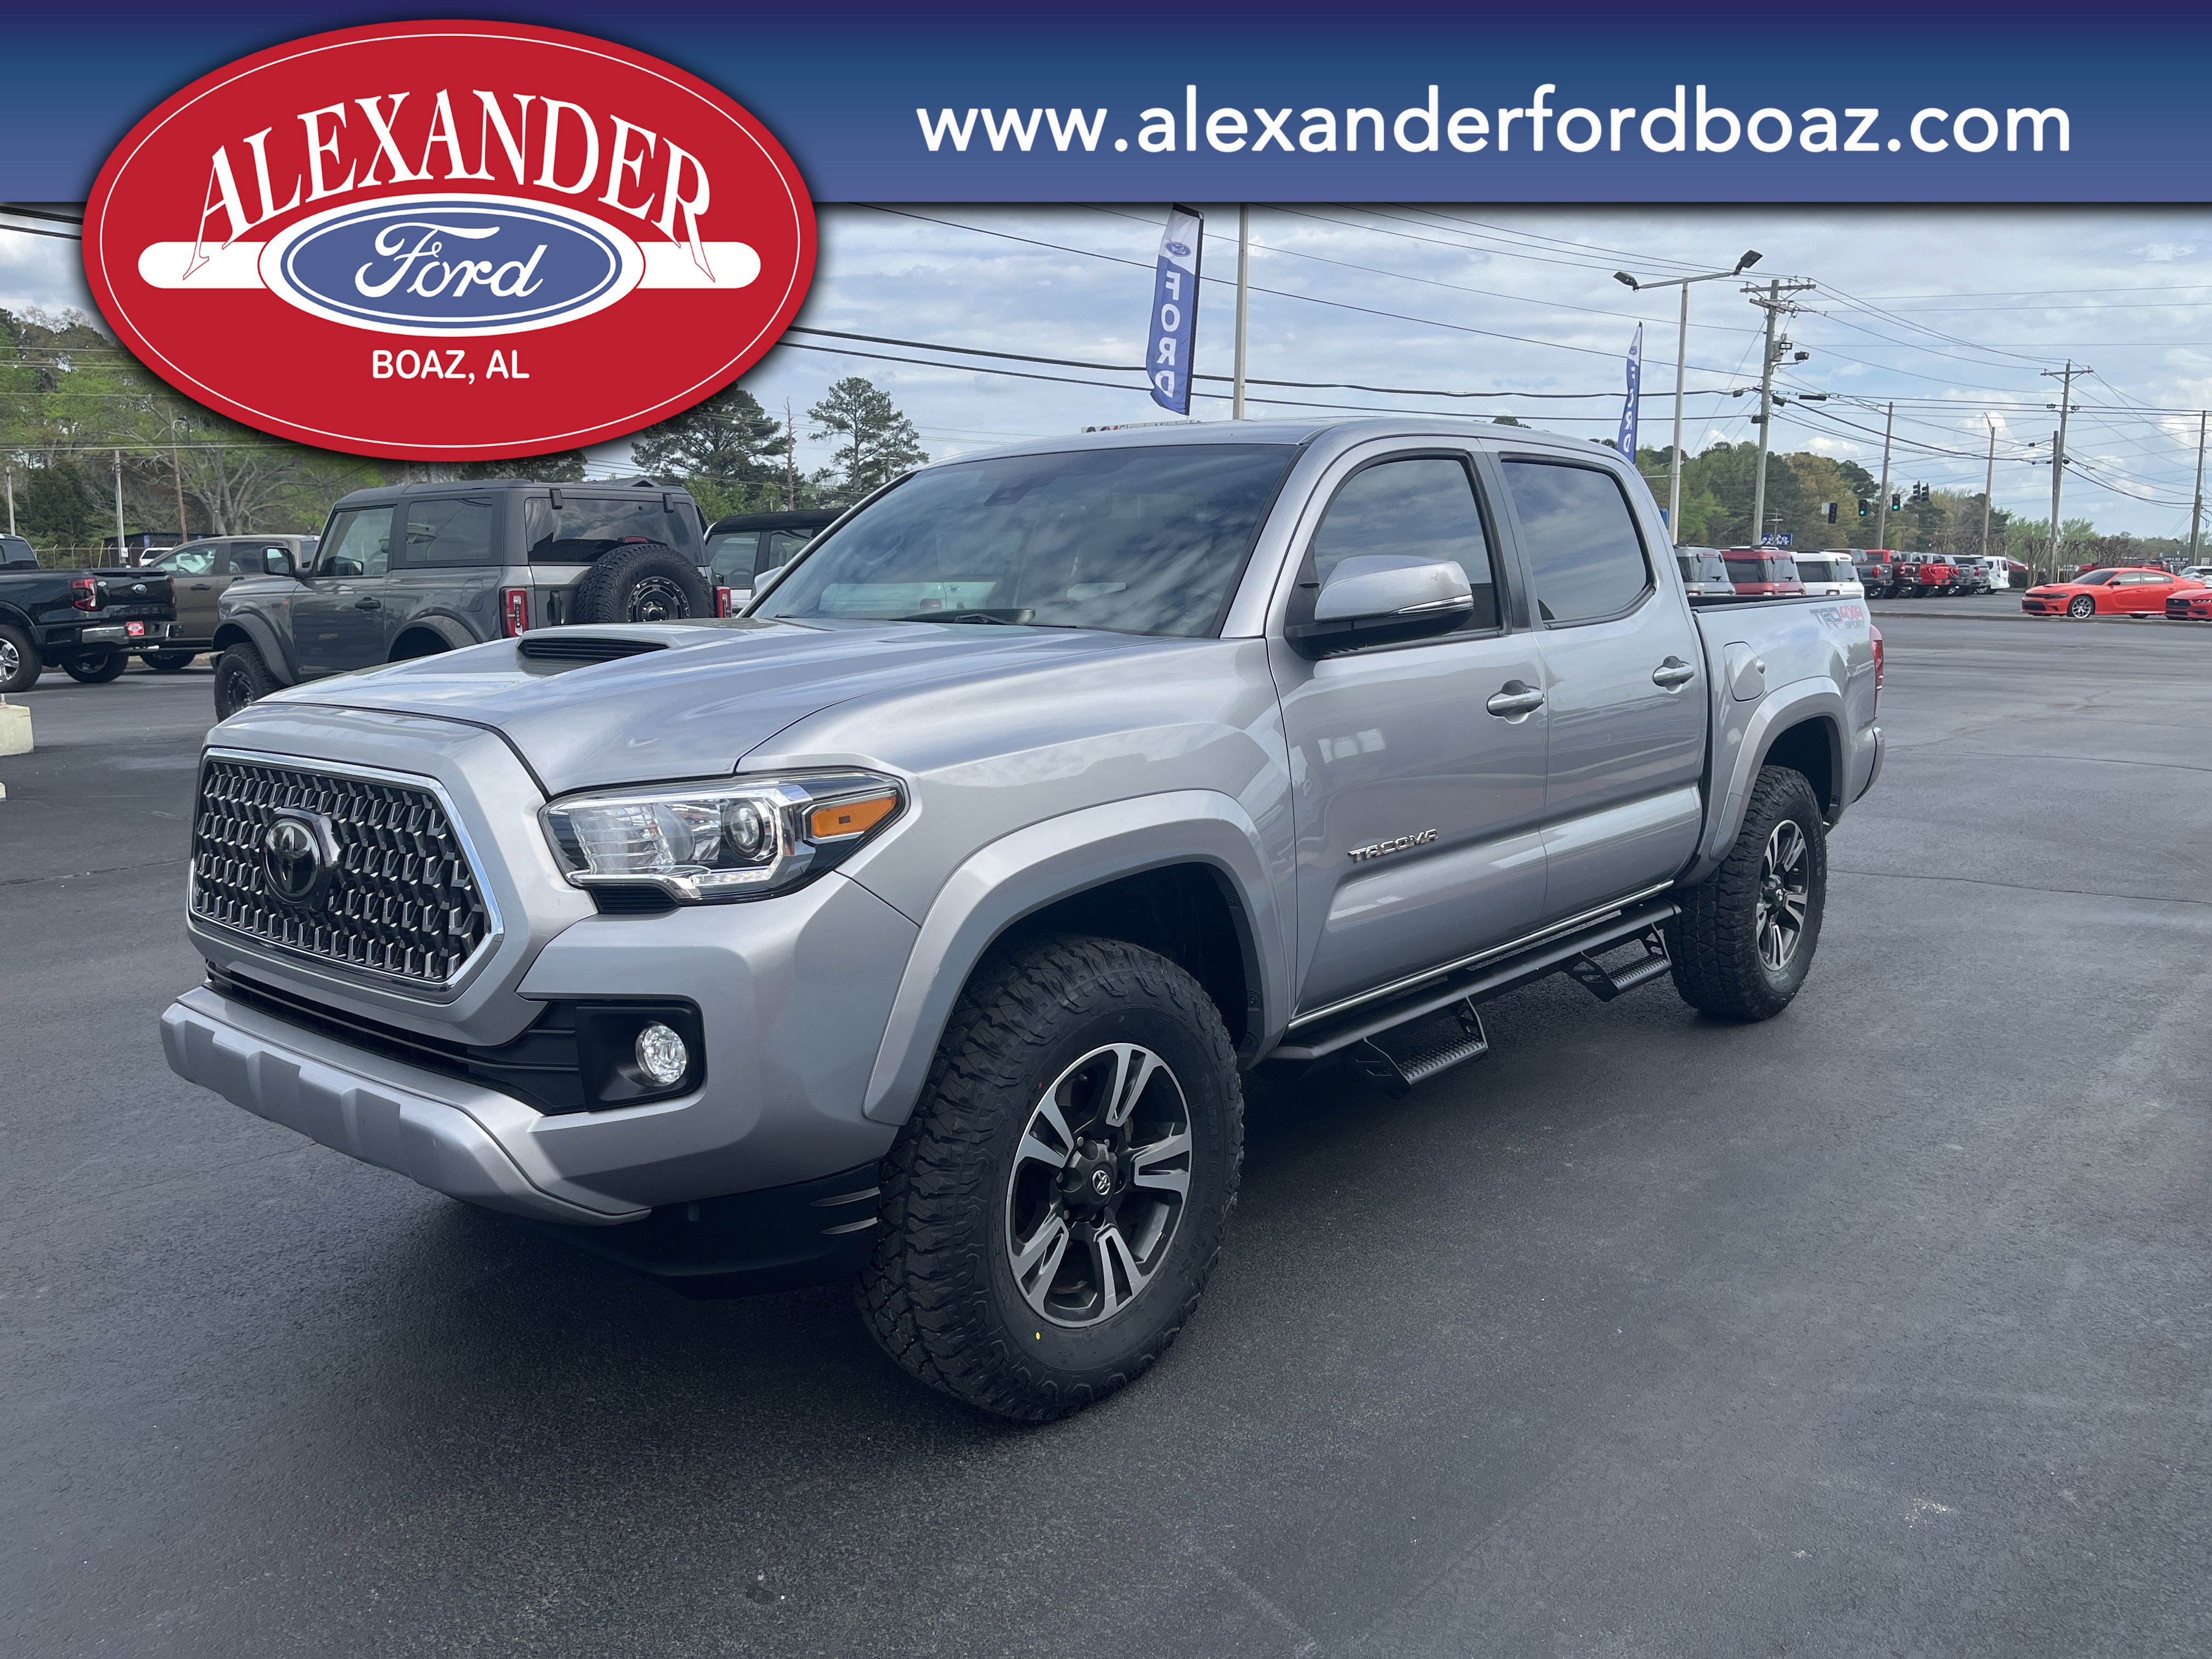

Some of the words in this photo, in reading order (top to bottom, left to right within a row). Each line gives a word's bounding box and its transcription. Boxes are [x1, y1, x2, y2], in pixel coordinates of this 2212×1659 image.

[1810, 607, 1842, 629] TRD
[1845, 620, 1865, 629] SPORT
[1347, 828, 1439, 862] TACOMA
